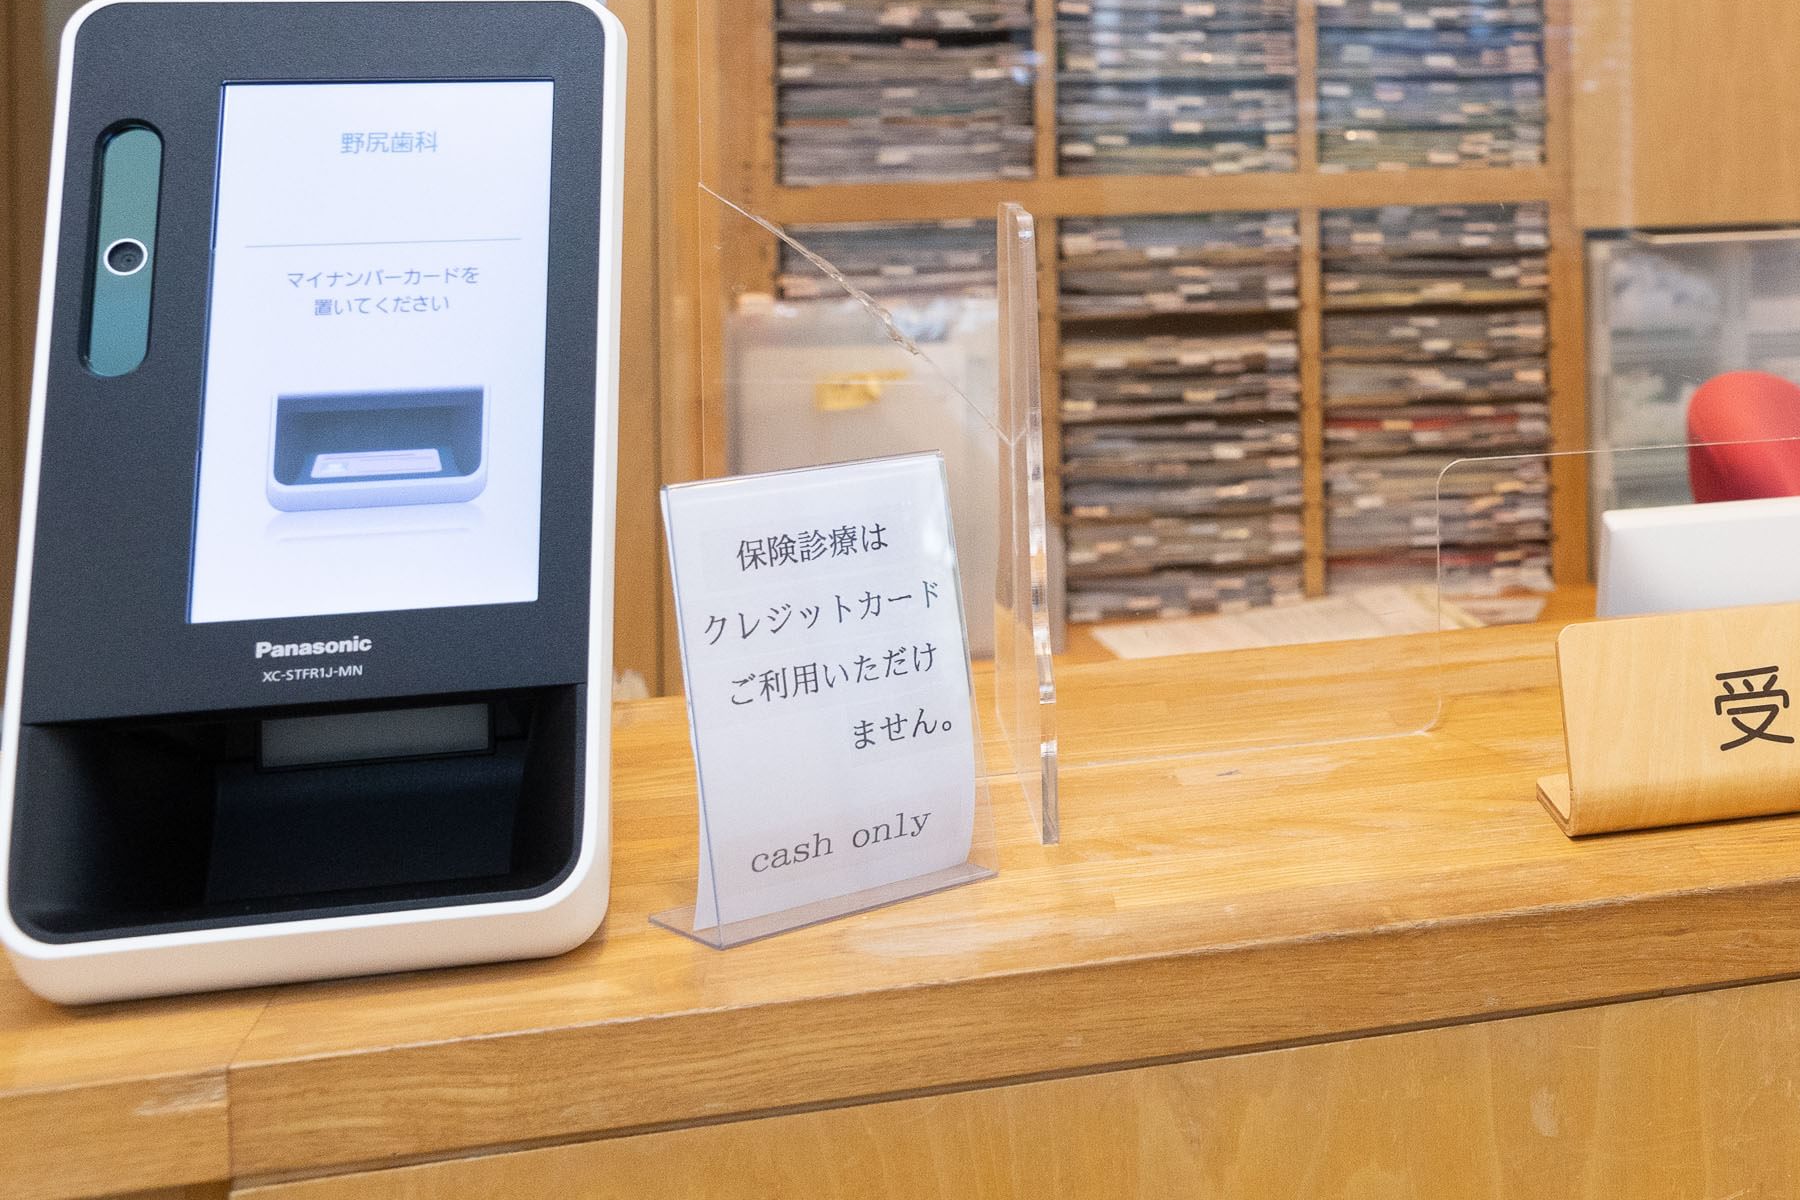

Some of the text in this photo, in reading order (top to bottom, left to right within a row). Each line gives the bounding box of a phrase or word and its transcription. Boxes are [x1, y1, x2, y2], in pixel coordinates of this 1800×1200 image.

[340, 131, 438, 154] 野尻歯科
[288, 267, 480, 288] マイナンバーカードを
[314, 297, 450, 316] 置いてください
[736, 523, 889, 572] 保険診療は
[703, 580, 940, 646] クレジットカード
[255, 635, 373, 659] Panasonic
[262, 664, 364, 683] XC-STFR1J-MN
[730, 642, 938, 707] ご利用いただけ
[853, 707, 953, 750] ません。
[750, 810, 932, 873] cash only
